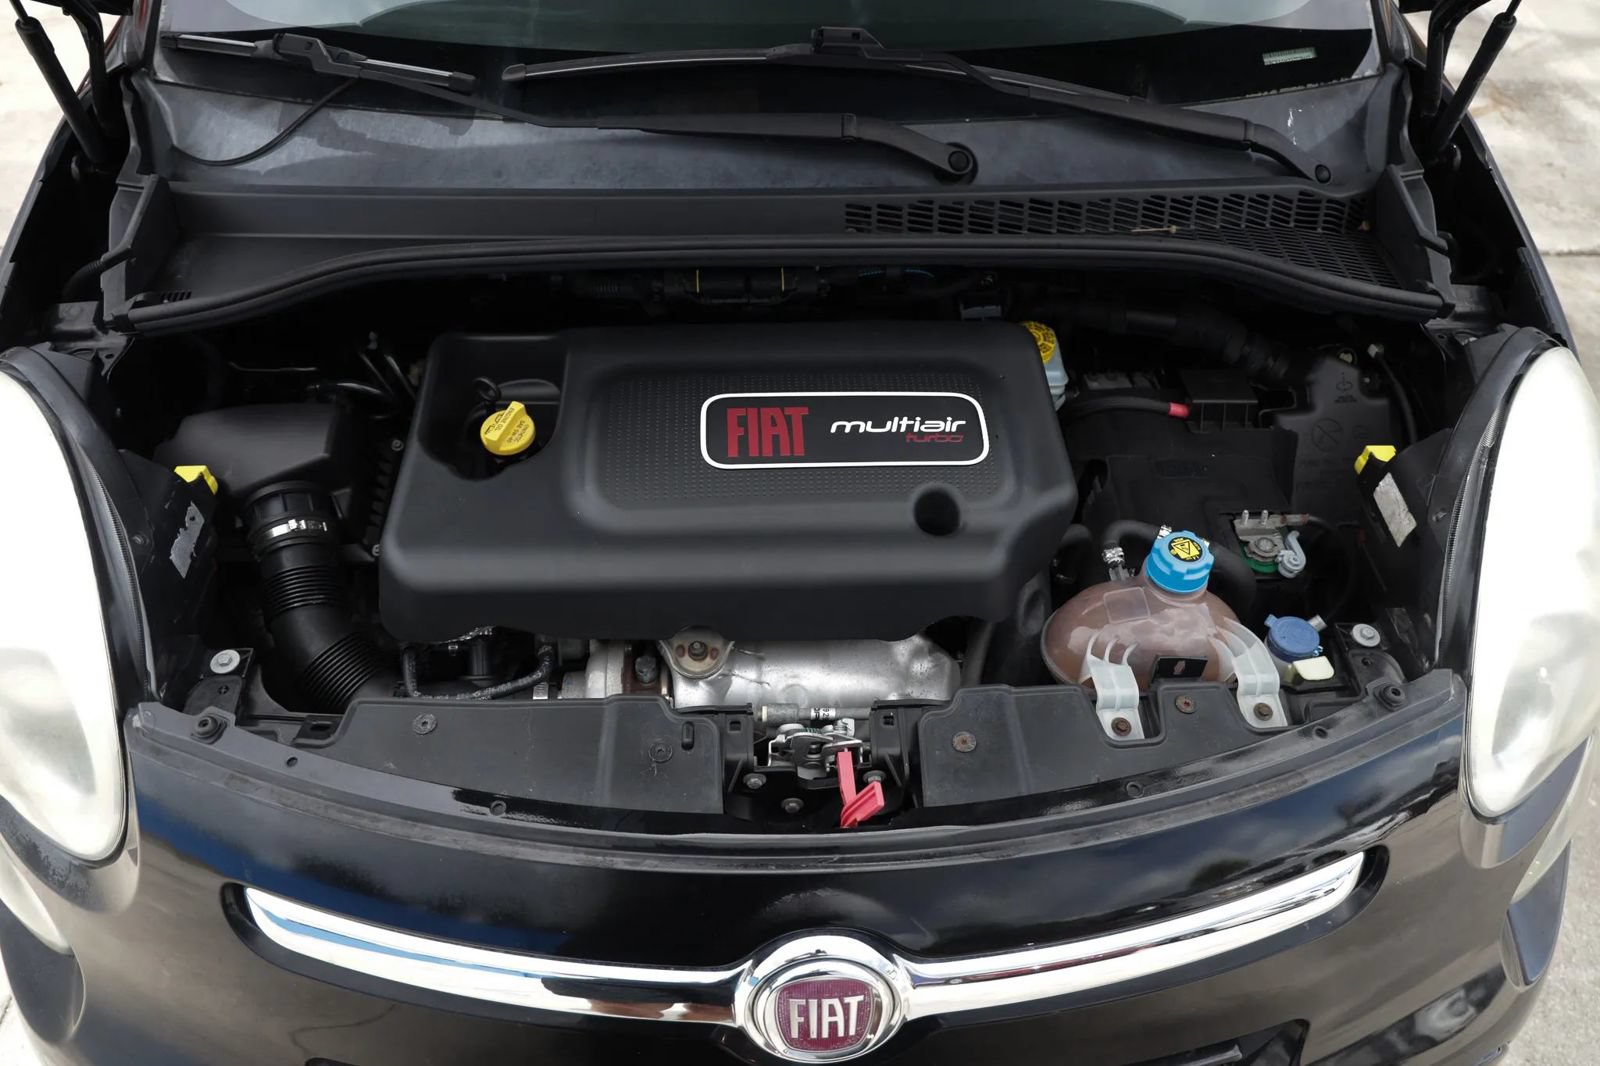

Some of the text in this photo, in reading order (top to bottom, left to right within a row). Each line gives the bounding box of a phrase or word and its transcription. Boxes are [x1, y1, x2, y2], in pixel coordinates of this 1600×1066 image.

[726, 406, 809, 458] FIAT
[830, 416, 967, 434] multiair
[905, 432, 964, 443] turbo
[788, 994, 865, 1039] FIAT
